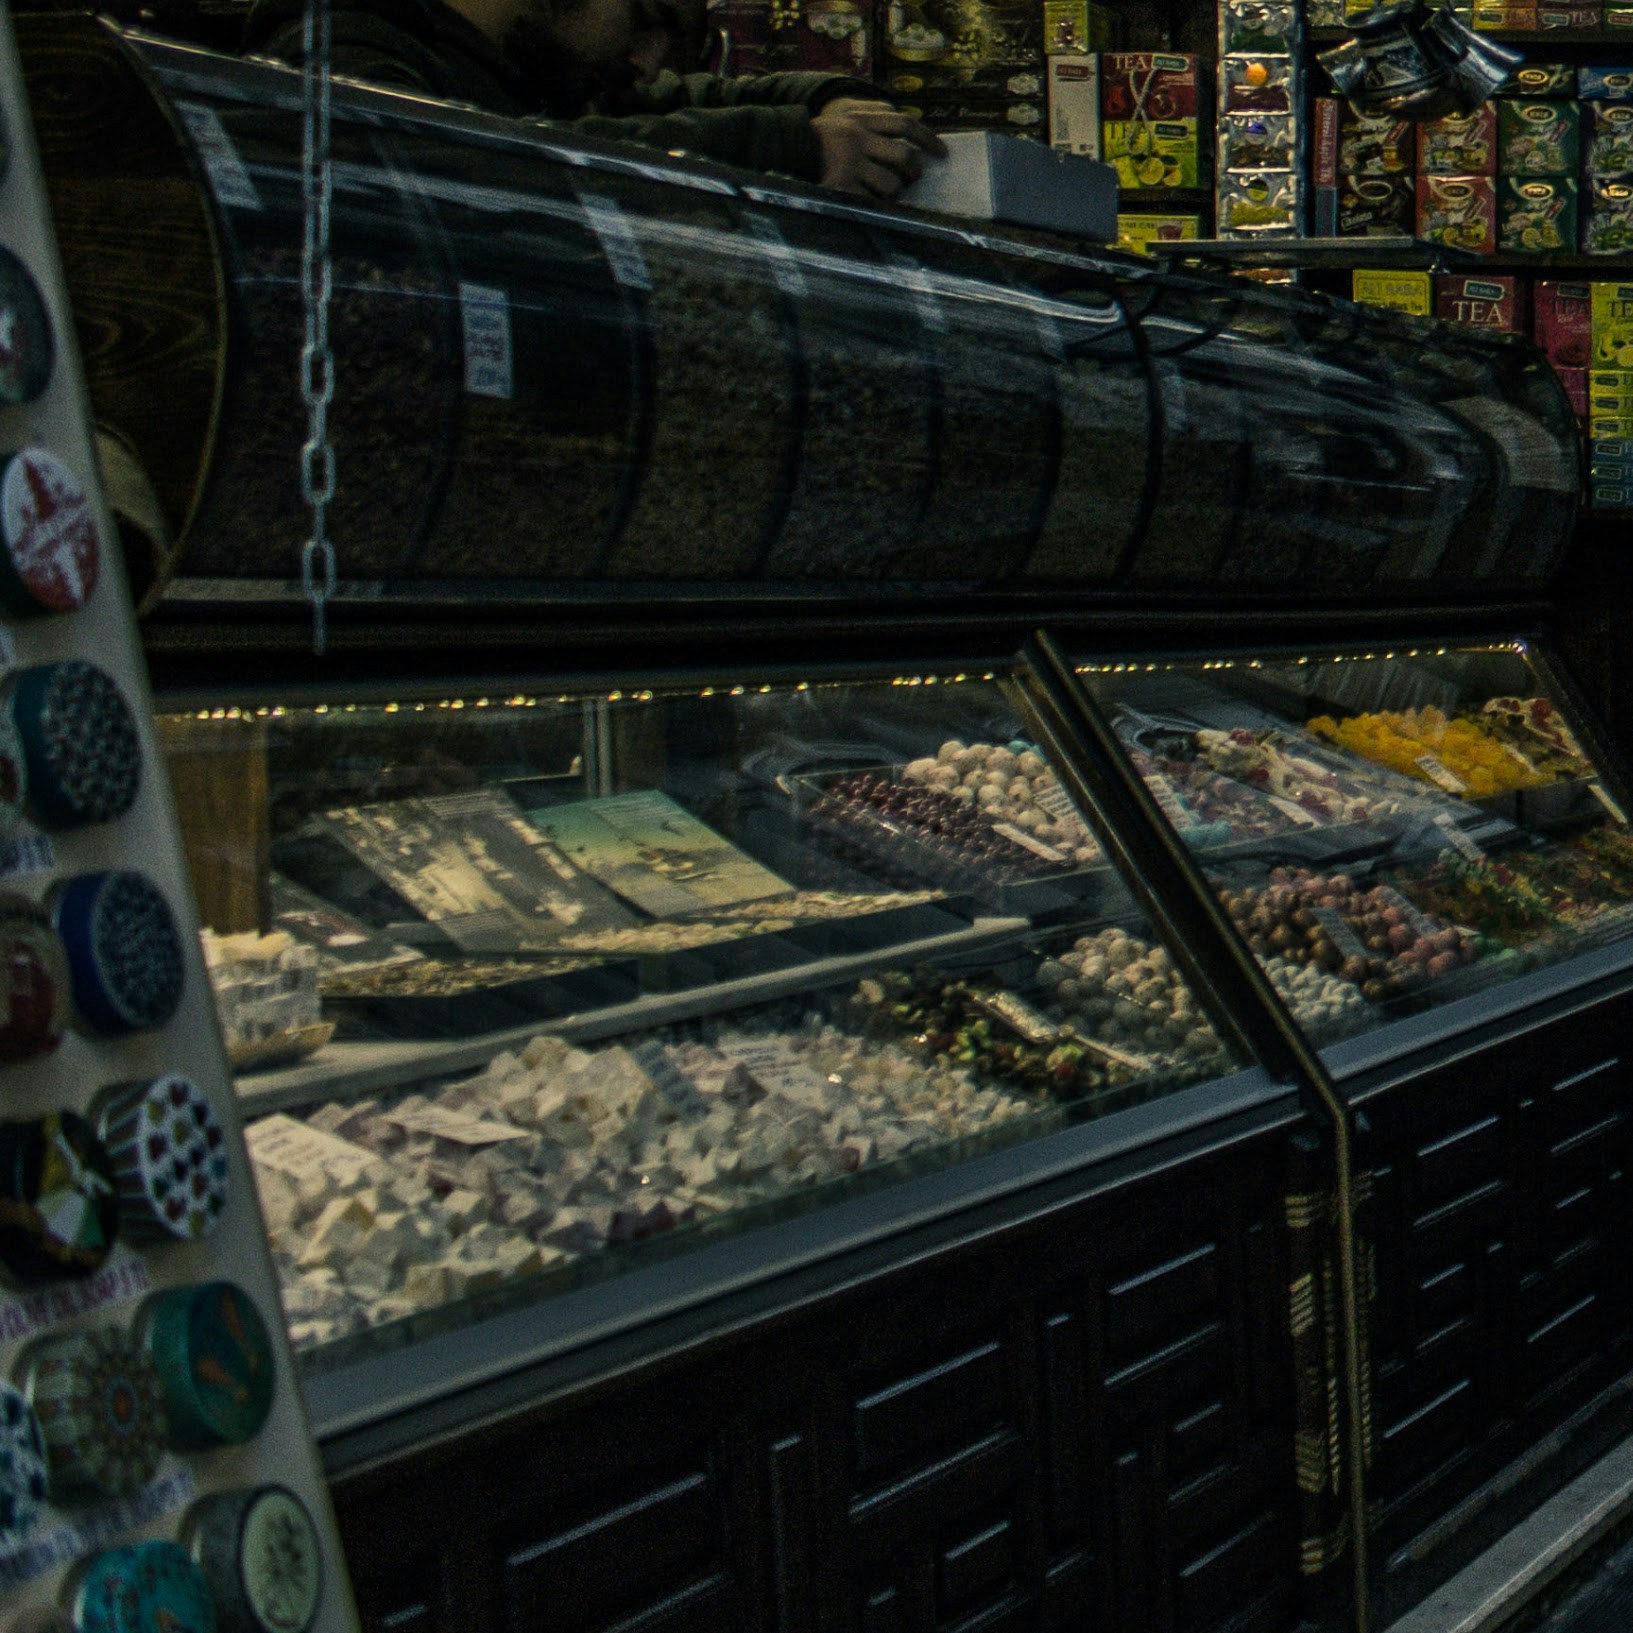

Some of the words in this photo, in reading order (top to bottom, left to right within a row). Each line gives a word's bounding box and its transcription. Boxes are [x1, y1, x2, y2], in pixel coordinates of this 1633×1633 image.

[1112, 55, 1147, 70] TEA
[1452, 301, 1505, 323] TEA
[1549, 299, 1589, 314] TEA
